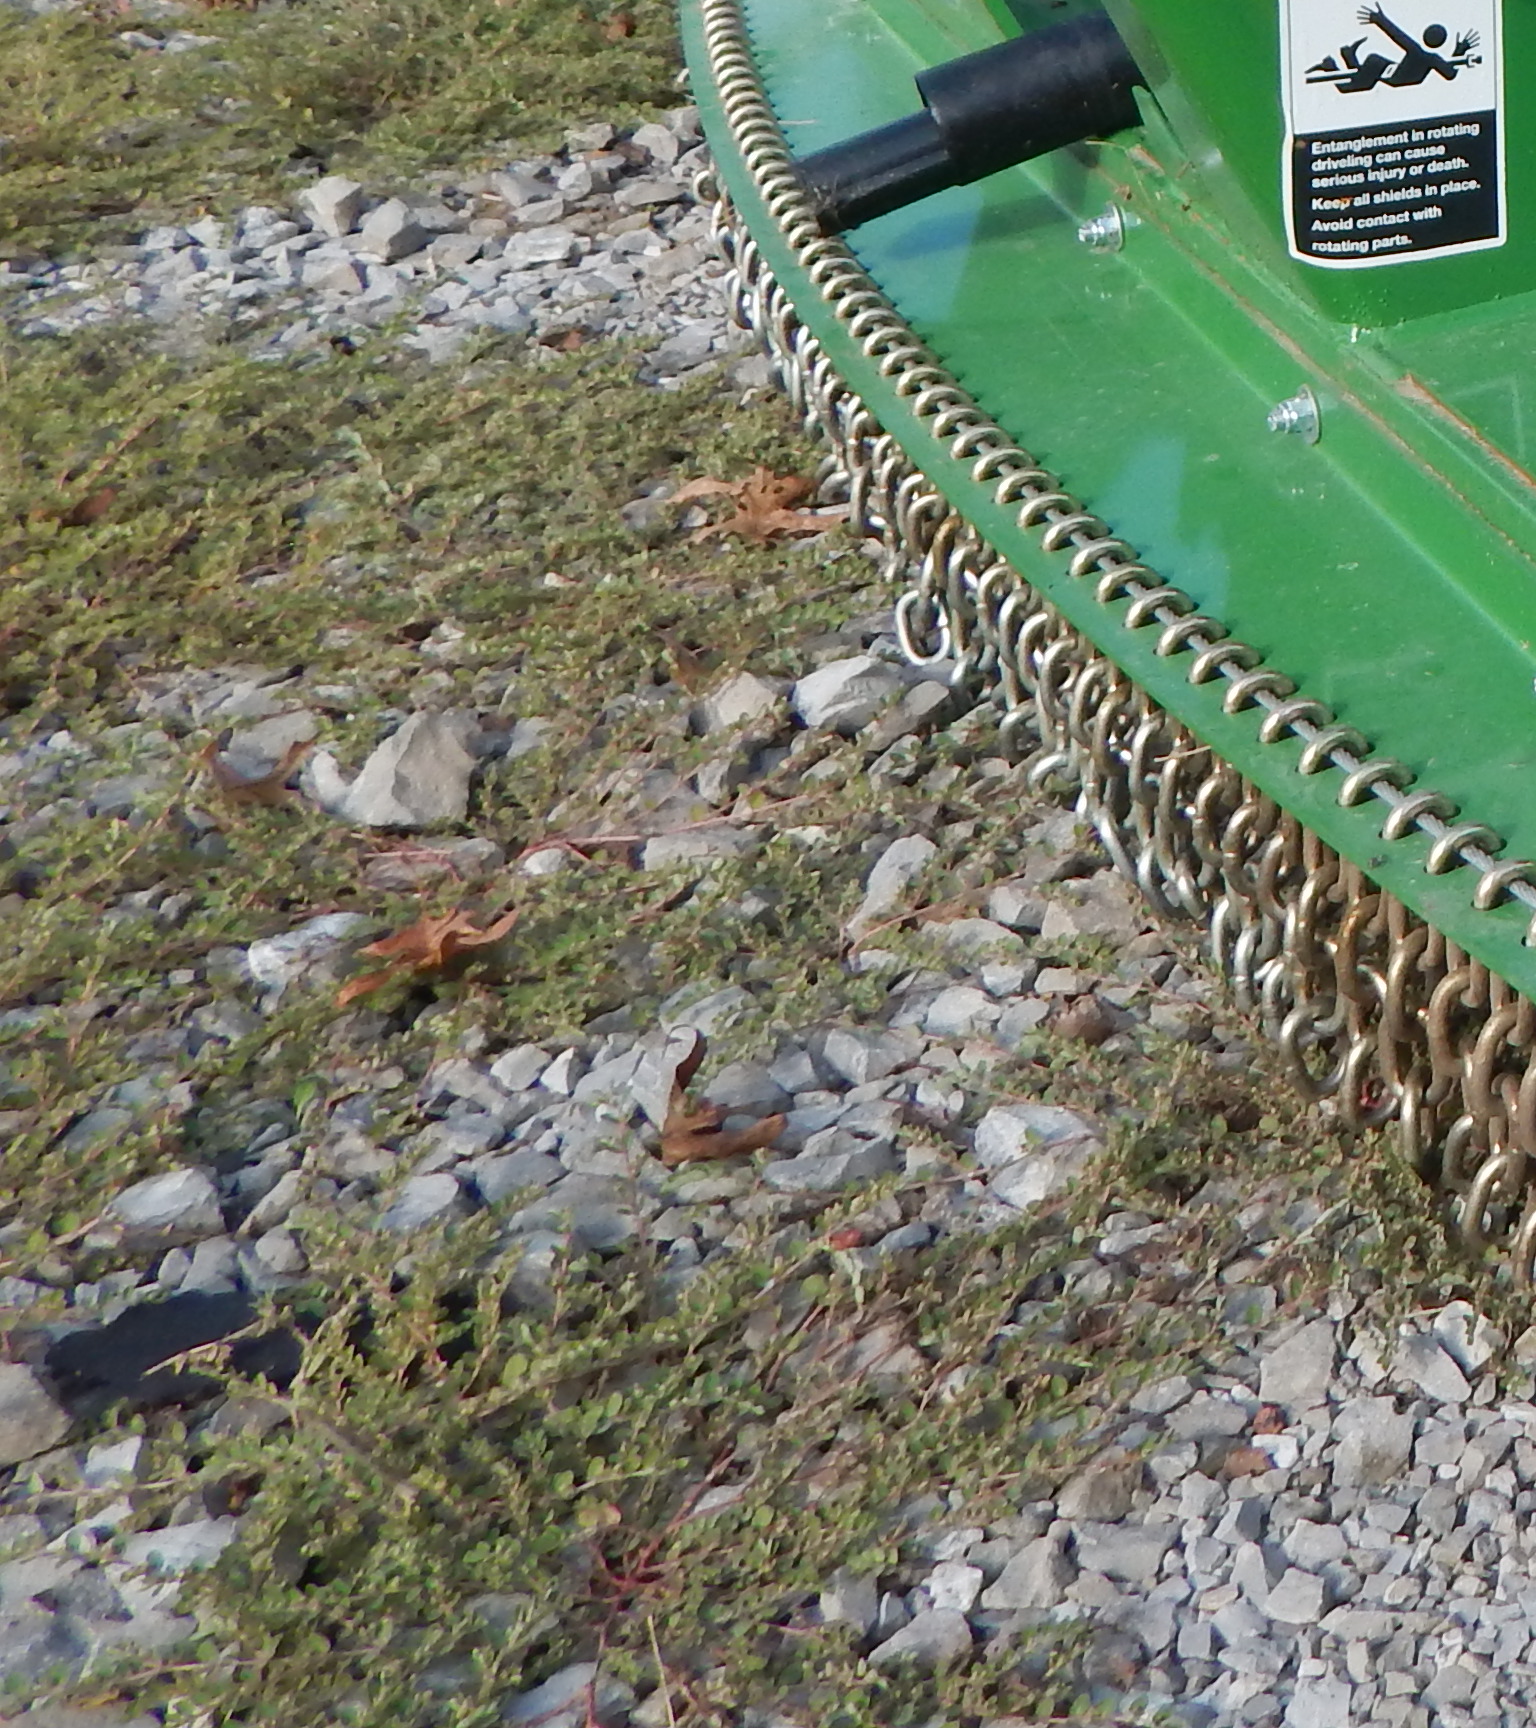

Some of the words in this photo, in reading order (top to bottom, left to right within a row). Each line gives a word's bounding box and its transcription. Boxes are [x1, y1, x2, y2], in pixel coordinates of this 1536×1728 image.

[1311, 130, 1409, 154] Entanglement
[1412, 129, 1425, 142] in
[1427, 122, 1480, 140] rotating
[1375, 149, 1401, 163] can
[1404, 143, 1446, 159] cause
[1311, 172, 1365, 189] serious
[1367, 166, 1406, 183] injury
[1409, 163, 1425, 176] or
[1427, 156, 1470, 173] death.
[1311, 197, 1350, 211] Keep
[1353, 193, 1370, 207] all
[1373, 186, 1422, 203] shields
[1425, 183, 1438, 197] in
[1440, 178, 1481, 196] place.
[1311, 217, 1353, 232] Avoid
[1356, 211, 1410, 228] contact
[1412, 205, 1443, 220] with
[1311, 238, 1370, 254] rotating
[1372, 234, 1413, 252] parts.
